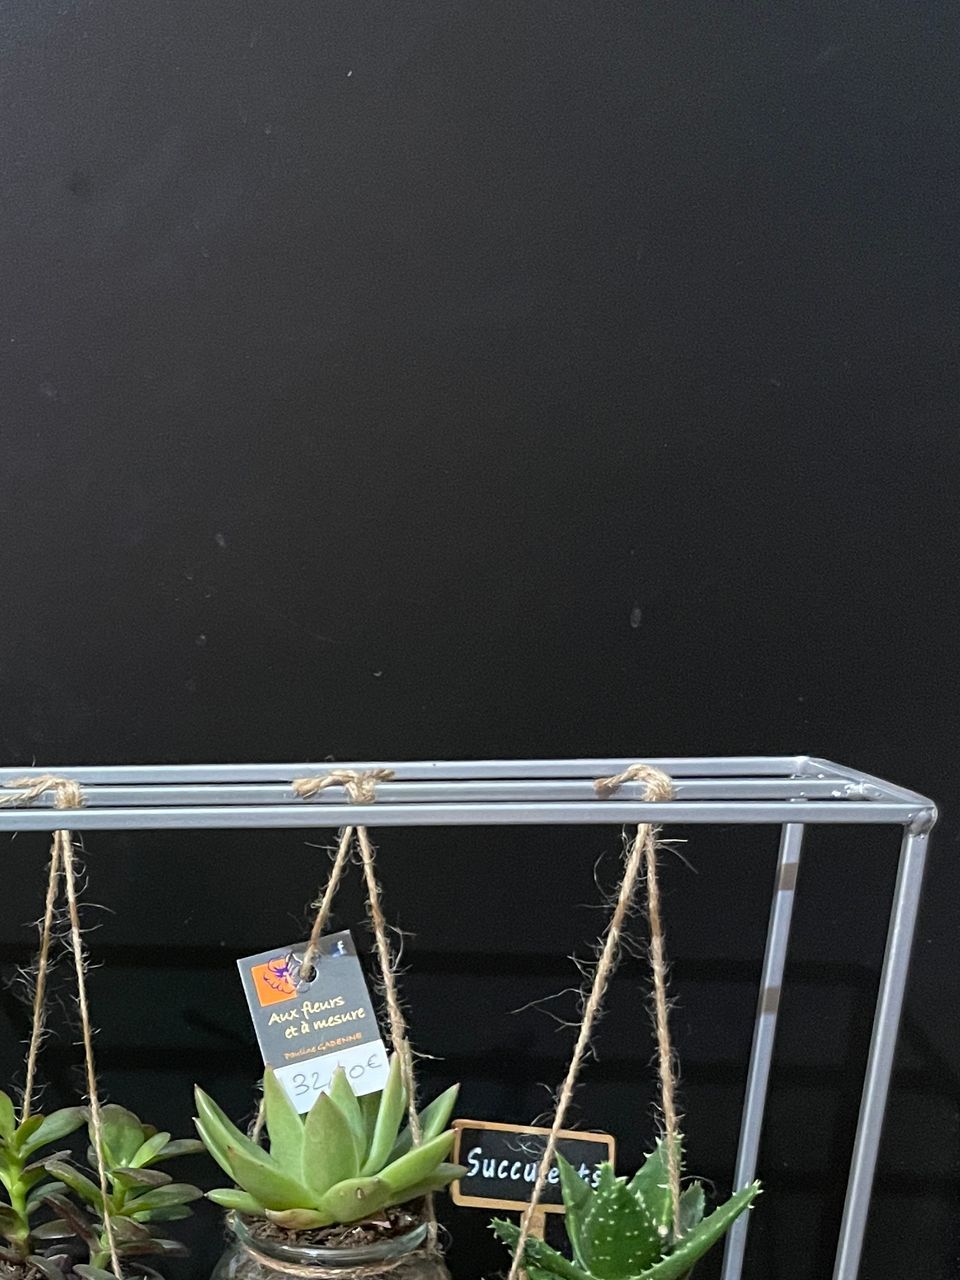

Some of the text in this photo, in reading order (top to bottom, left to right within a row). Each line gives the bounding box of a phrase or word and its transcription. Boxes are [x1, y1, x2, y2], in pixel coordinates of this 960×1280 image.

[268, 996, 345, 1026] Aux fleurs
[285, 1007, 366, 1039] et à mesure
[317, 1031, 363, 1051] GADENNE
[466, 1146, 602, 1188] Succuets
